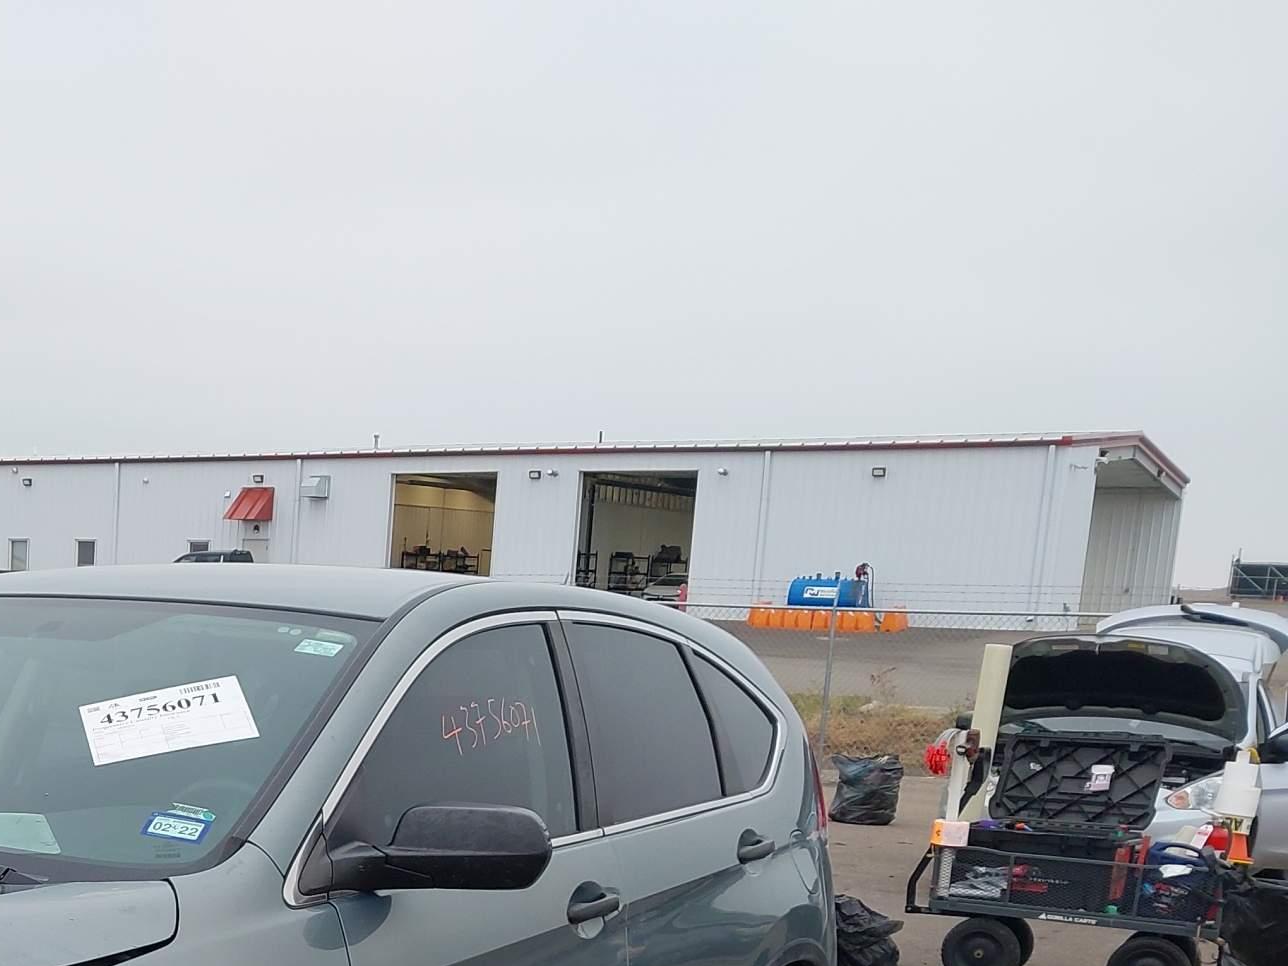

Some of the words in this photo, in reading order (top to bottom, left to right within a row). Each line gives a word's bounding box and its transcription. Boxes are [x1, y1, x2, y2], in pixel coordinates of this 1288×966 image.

[100, 693, 220, 724] 43756071
[441, 697, 542, 756] 43756071
[153, 821, 172, 832] 02
[178, 825, 199, 837] 22
